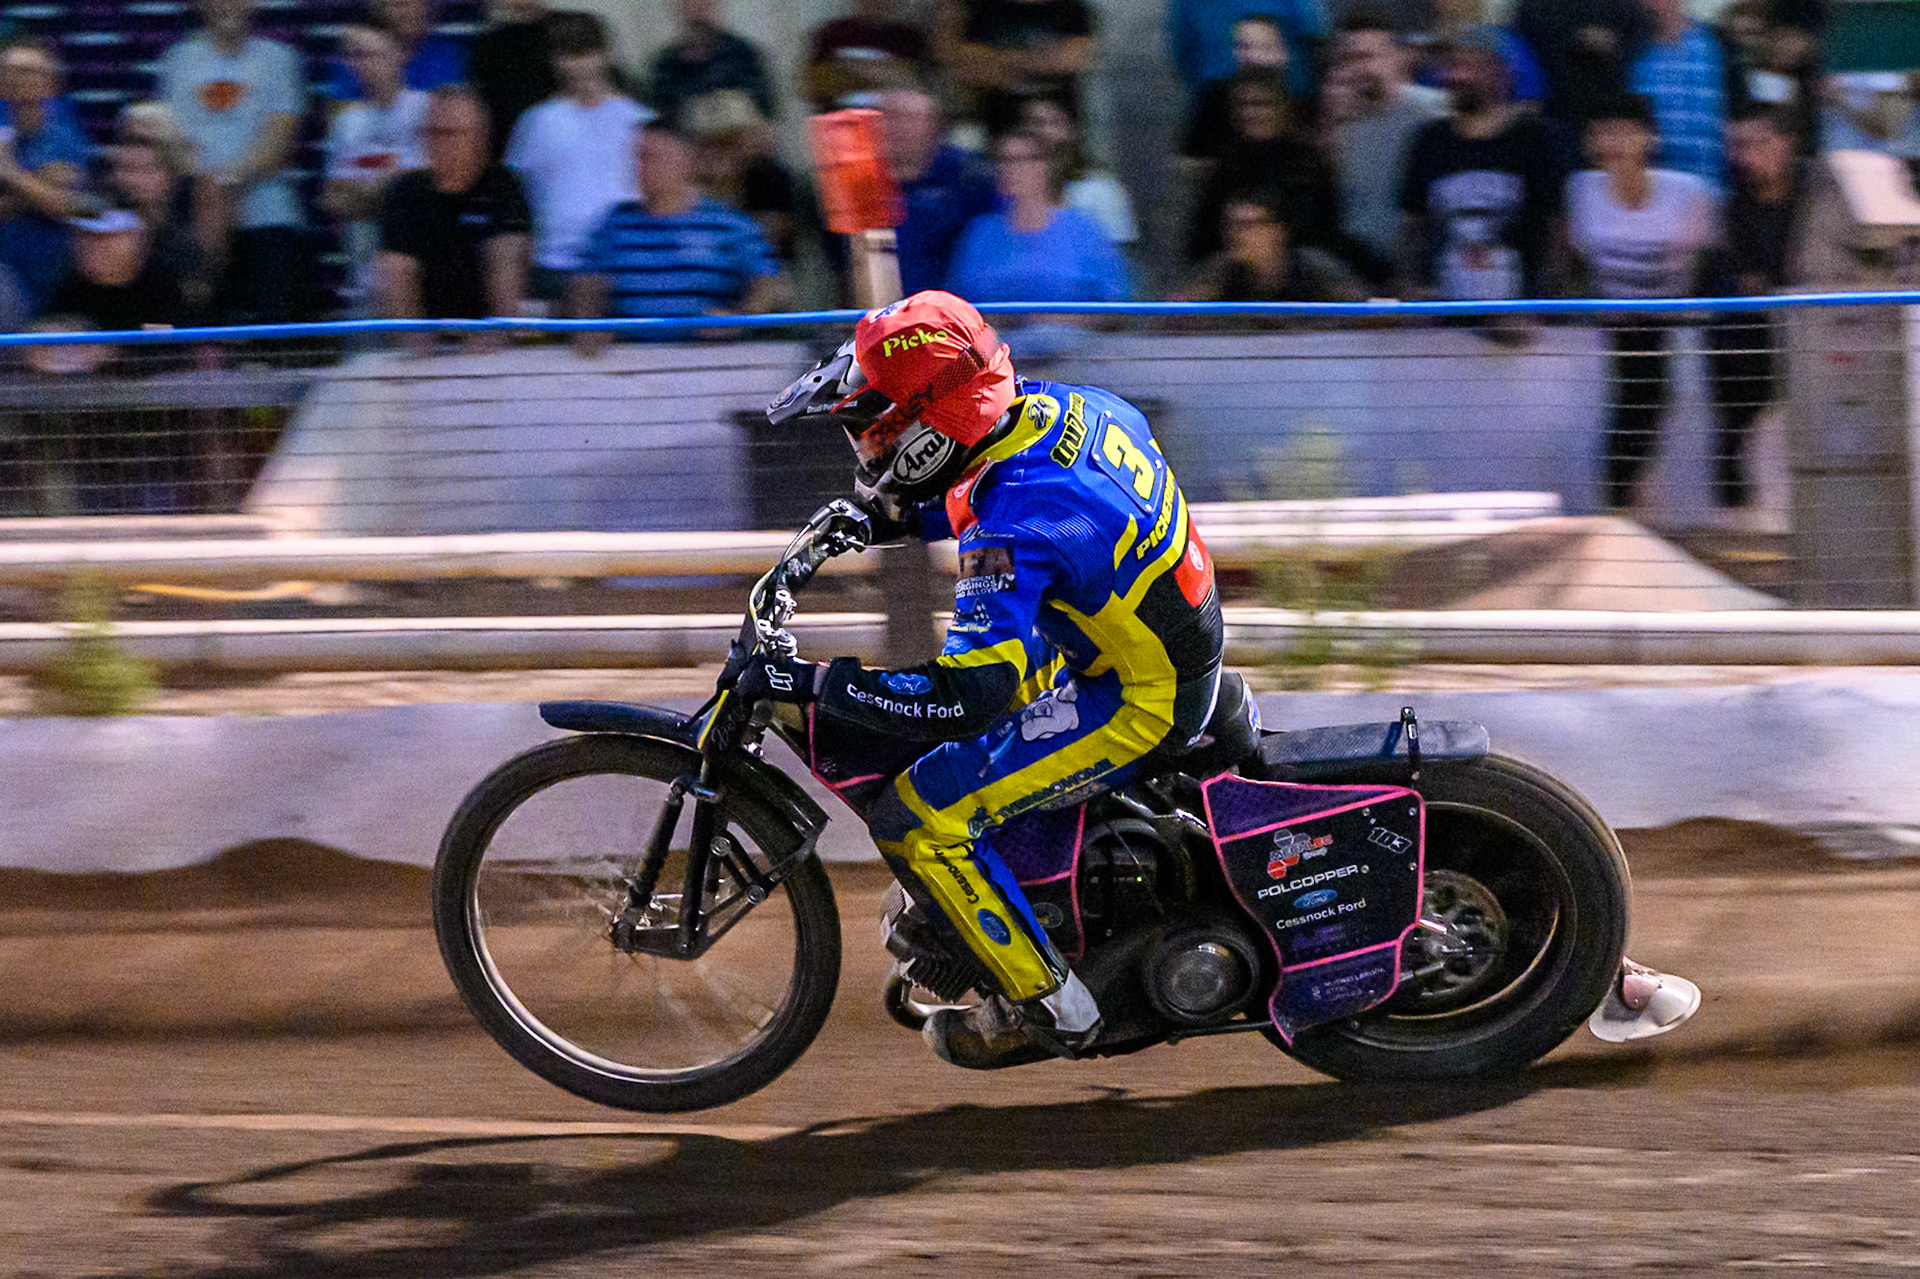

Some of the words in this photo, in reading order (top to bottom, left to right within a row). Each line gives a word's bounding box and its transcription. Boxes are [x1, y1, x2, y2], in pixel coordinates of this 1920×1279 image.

[882, 328, 948, 358] Picko
[1102, 423, 1156, 501] 3
[846, 683, 923, 718] Cessnock
[926, 700, 965, 719] Ford
[1257, 864, 1359, 900] POLCOPPER
[1276, 906, 1337, 931] Cessnock
[1338, 898, 1367, 916] Ford
